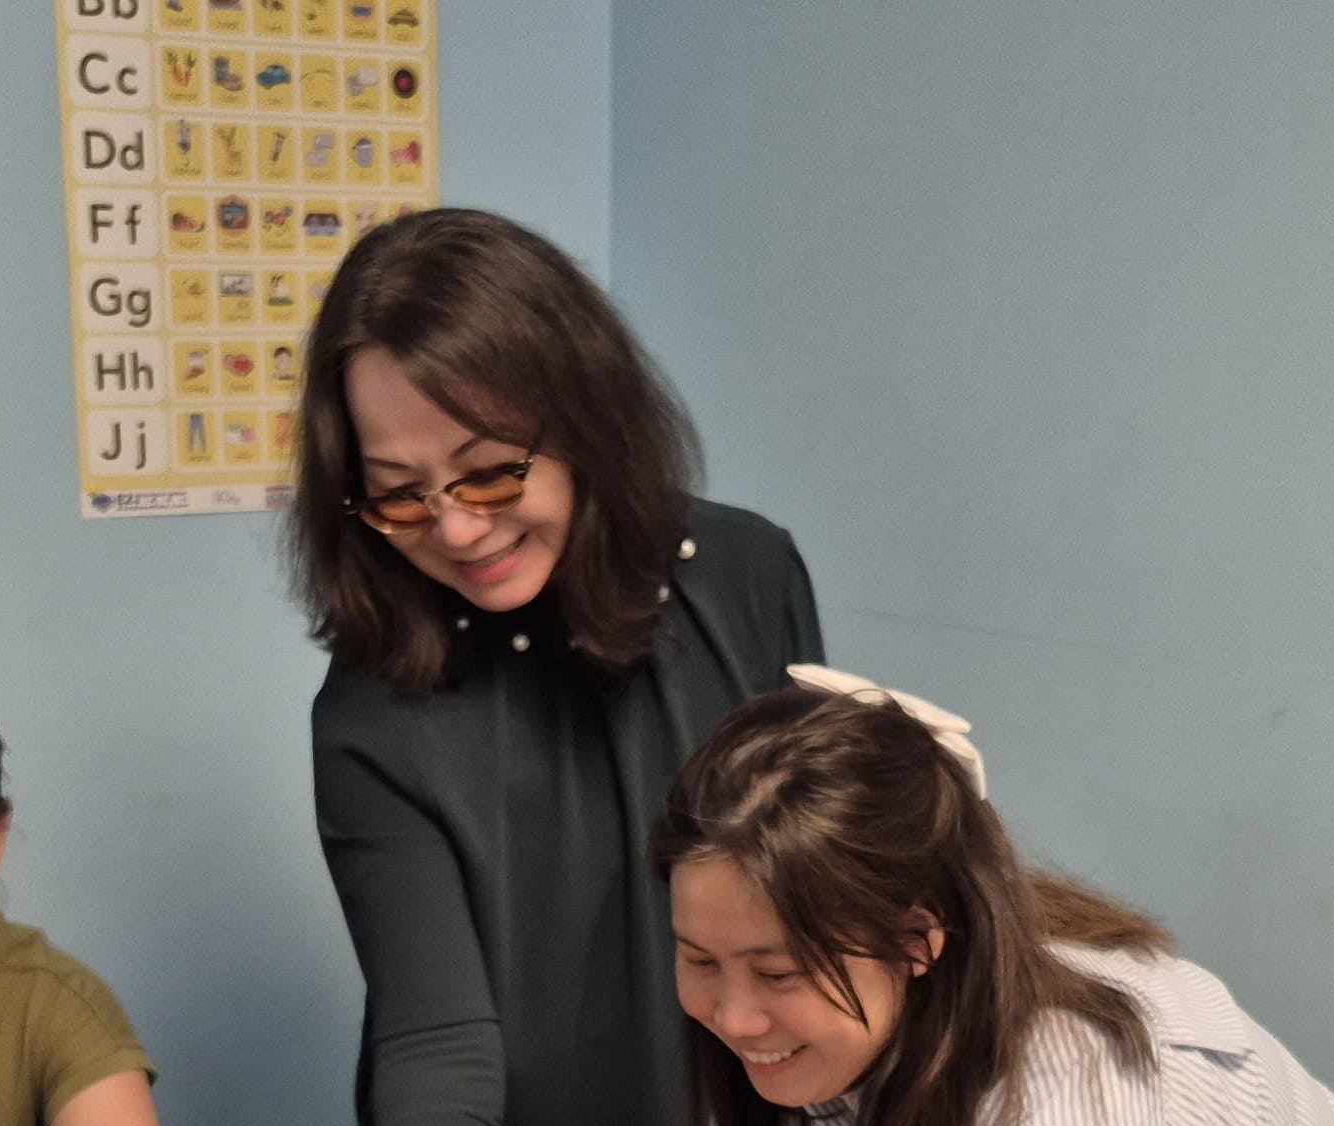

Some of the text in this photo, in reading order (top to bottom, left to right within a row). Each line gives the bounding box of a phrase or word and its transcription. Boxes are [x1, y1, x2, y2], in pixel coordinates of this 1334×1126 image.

[79, 52, 138, 95] Cc
[84, 130, 144, 171] Dd
[90, 277, 151, 328] Gg
[95, 350, 154, 391] Hh
